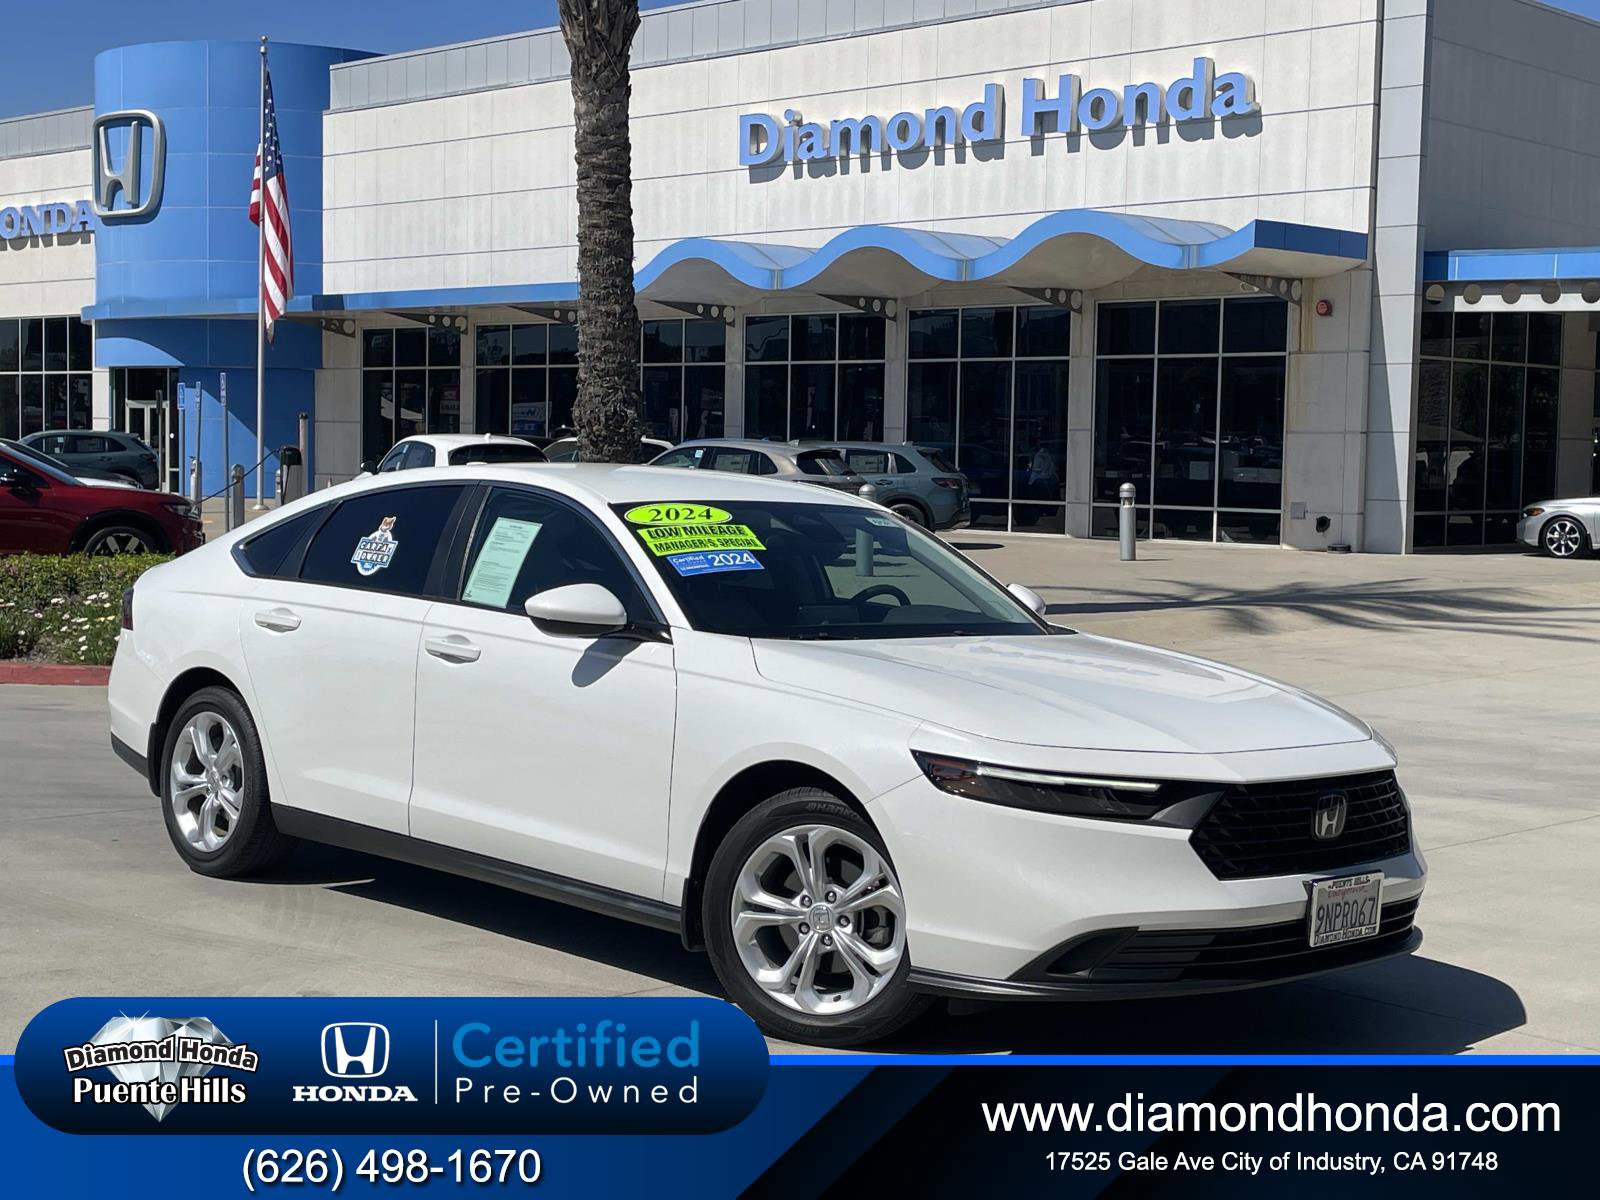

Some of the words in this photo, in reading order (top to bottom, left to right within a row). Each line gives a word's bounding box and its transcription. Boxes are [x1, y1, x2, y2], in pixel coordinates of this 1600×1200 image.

[739, 83, 1004, 167] Diamond
[1020, 56, 1258, 137] Honda
[0, 200, 96, 239] ONDA
[648, 507, 713, 522] 2024
[647, 526, 682, 540] LOW
[683, 524, 745, 537] MILEAGE
[654, 539, 716, 553] MANAGER'S
[718, 538, 761, 548] SPECIAL
[708, 553, 756, 566] 2024
[1315, 897, 1376, 933] 9NPR067
